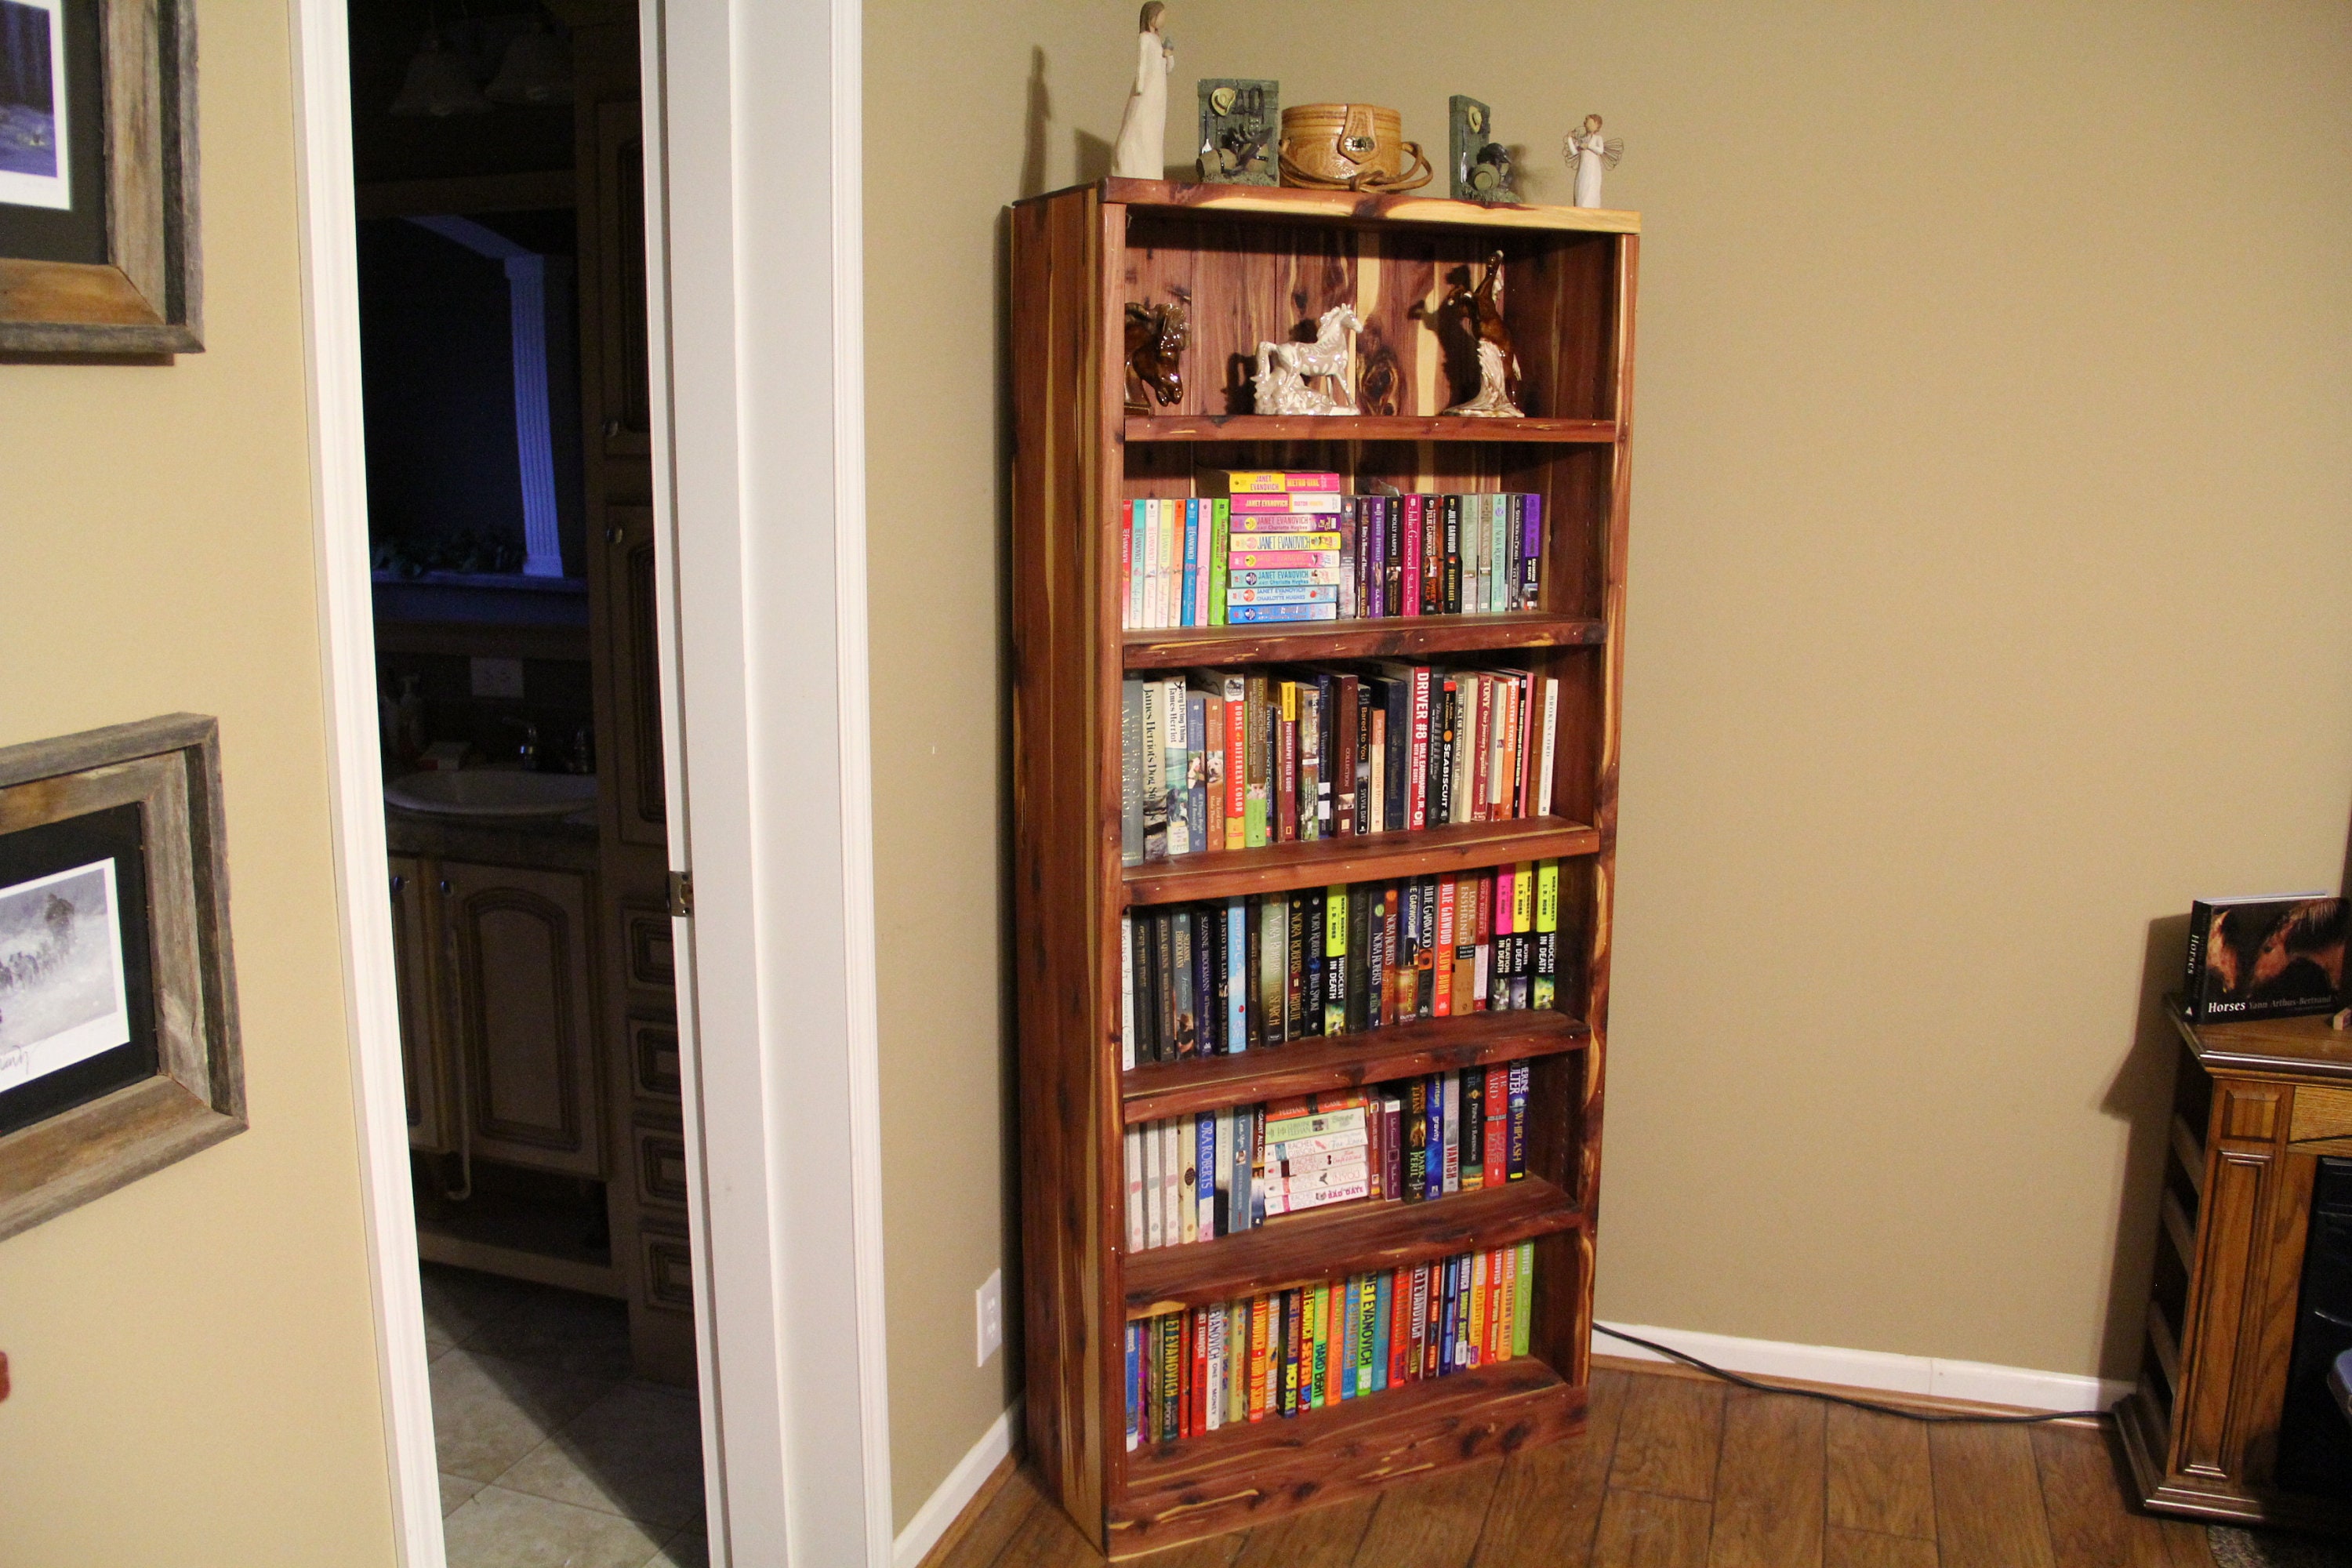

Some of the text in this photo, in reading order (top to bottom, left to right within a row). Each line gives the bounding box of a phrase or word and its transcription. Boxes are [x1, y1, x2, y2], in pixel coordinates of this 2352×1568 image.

[1258, 535, 1311, 550] JANET EVANOVICH
[1277, 570, 1308, 579] EVANOVICH
[1143, 689, 1155, 719] James
[1169, 688, 1178, 742] James Herriot
[1178, 704, 1186, 743] Living Thing
[1416, 673, 1429, 739] DRIVER #8
[1360, 733, 1367, 742] to
[1417, 742, 1426, 759] DALE
[1146, 765, 1156, 784] Dog
[1442, 743, 1451, 808] SEABISCUIT
[1290, 913, 1301, 937] NORA
[1459, 886, 1469, 945] ENSHRINED
[1290, 939, 1301, 974] ROBERTS
[1371, 932, 1383, 985] NORA ROBERTS
[1385, 913, 1396, 965] NORA ROBERTS
[1438, 884, 1452, 995] JULIE GARWOOD SLOW BURN
[1538, 936, 1547, 973] IN DEATH
[2187, 934, 2200, 975] Horses
[1329, 960, 1338, 999] IN DEATH
[1269, 996, 1282, 1026] SEARCH
[2208, 1001, 2246, 1014] Horses
[1512, 1111, 1523, 1161] WHIPLASH
[1197, 1145, 1210, 1189] ROBERTS
[1410, 1152, 1418, 1178] PERIL
[1446, 1145, 1457, 1179] VANISH
[1361, 1301, 1374, 1366] EVANOVICH
[1164, 1334, 1179, 1397] EVANOVICH
[1301, 1341, 1313, 1385] SEVEN
